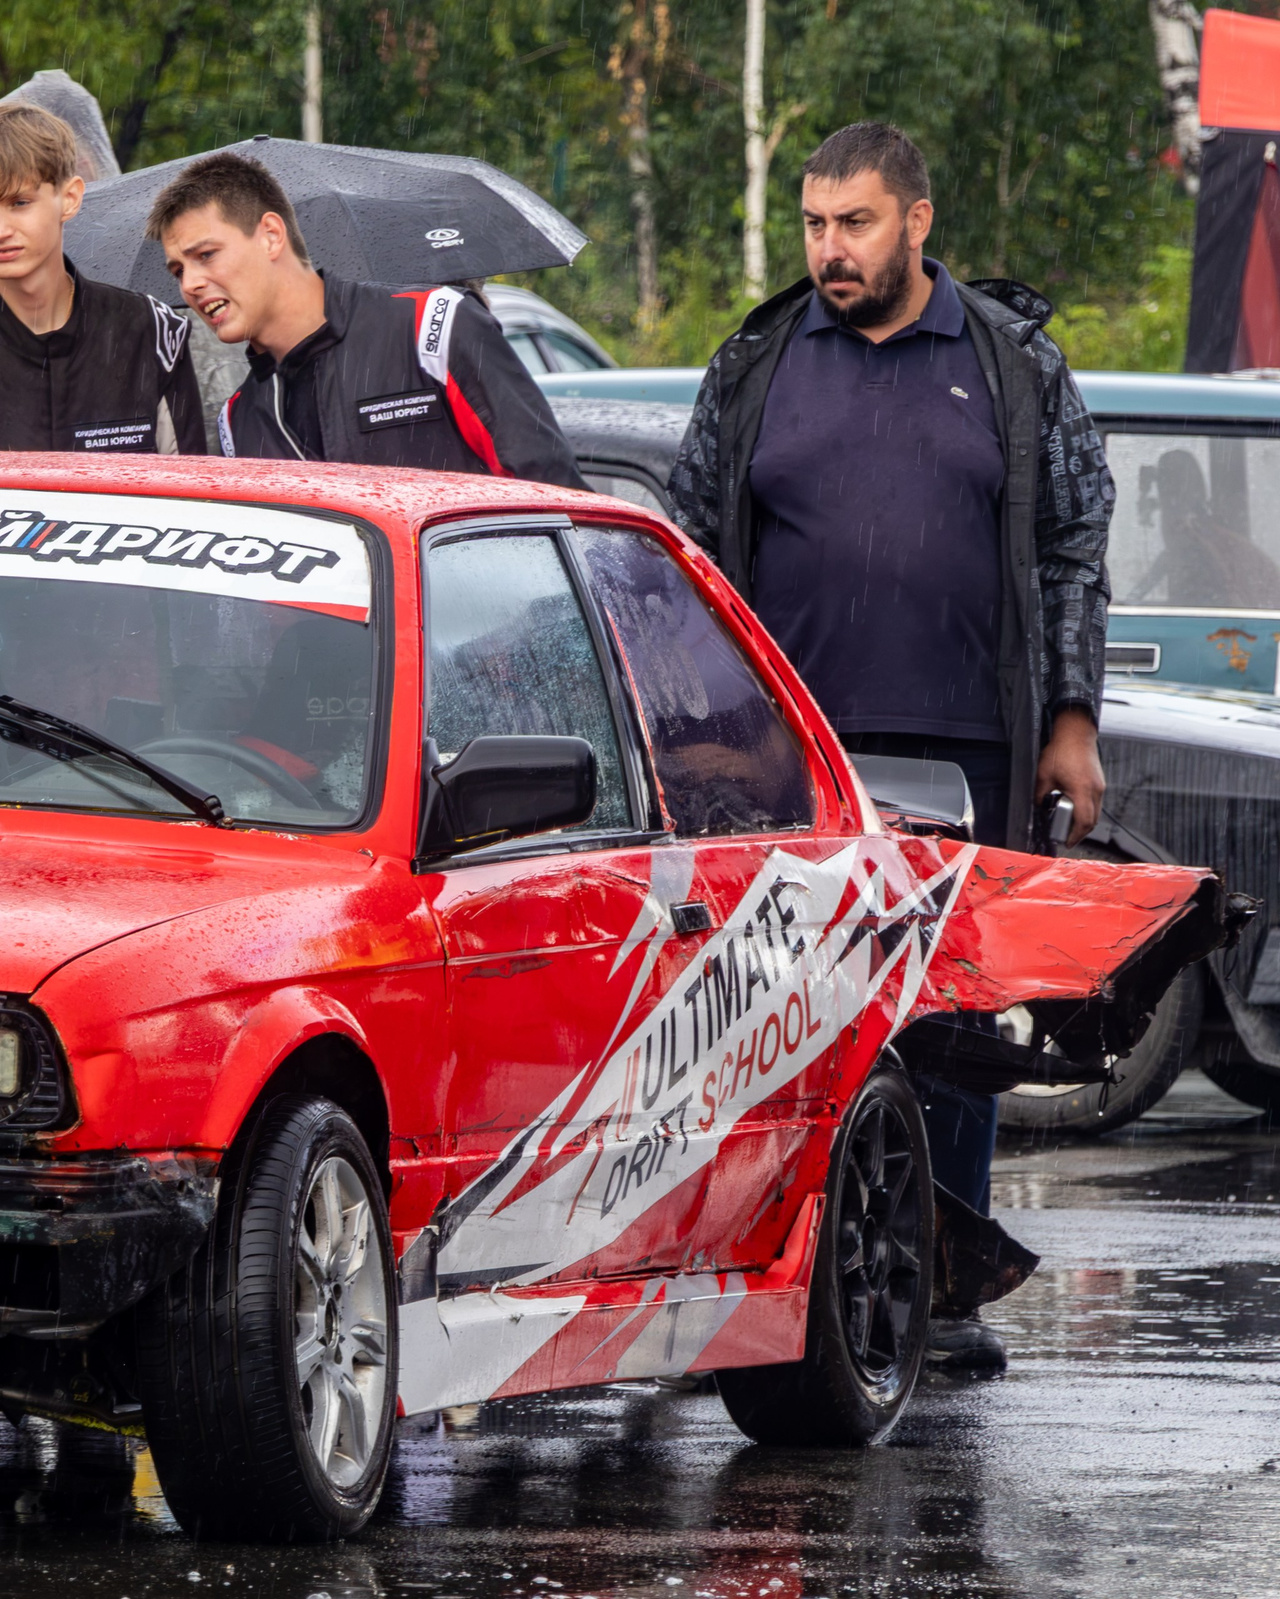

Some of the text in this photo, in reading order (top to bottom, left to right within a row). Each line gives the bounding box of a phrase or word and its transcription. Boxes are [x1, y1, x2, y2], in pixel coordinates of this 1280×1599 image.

[85, 435, 143, 448] ВАШ ЮРИСТ
[369, 405, 430, 424] ВАШ ЮРИСТ
[35, 521, 338, 584] ДРИФТ
[641, 874, 807, 1111] ULTIMATE
[600, 978, 822, 1220] DRIFT SCHOOL
